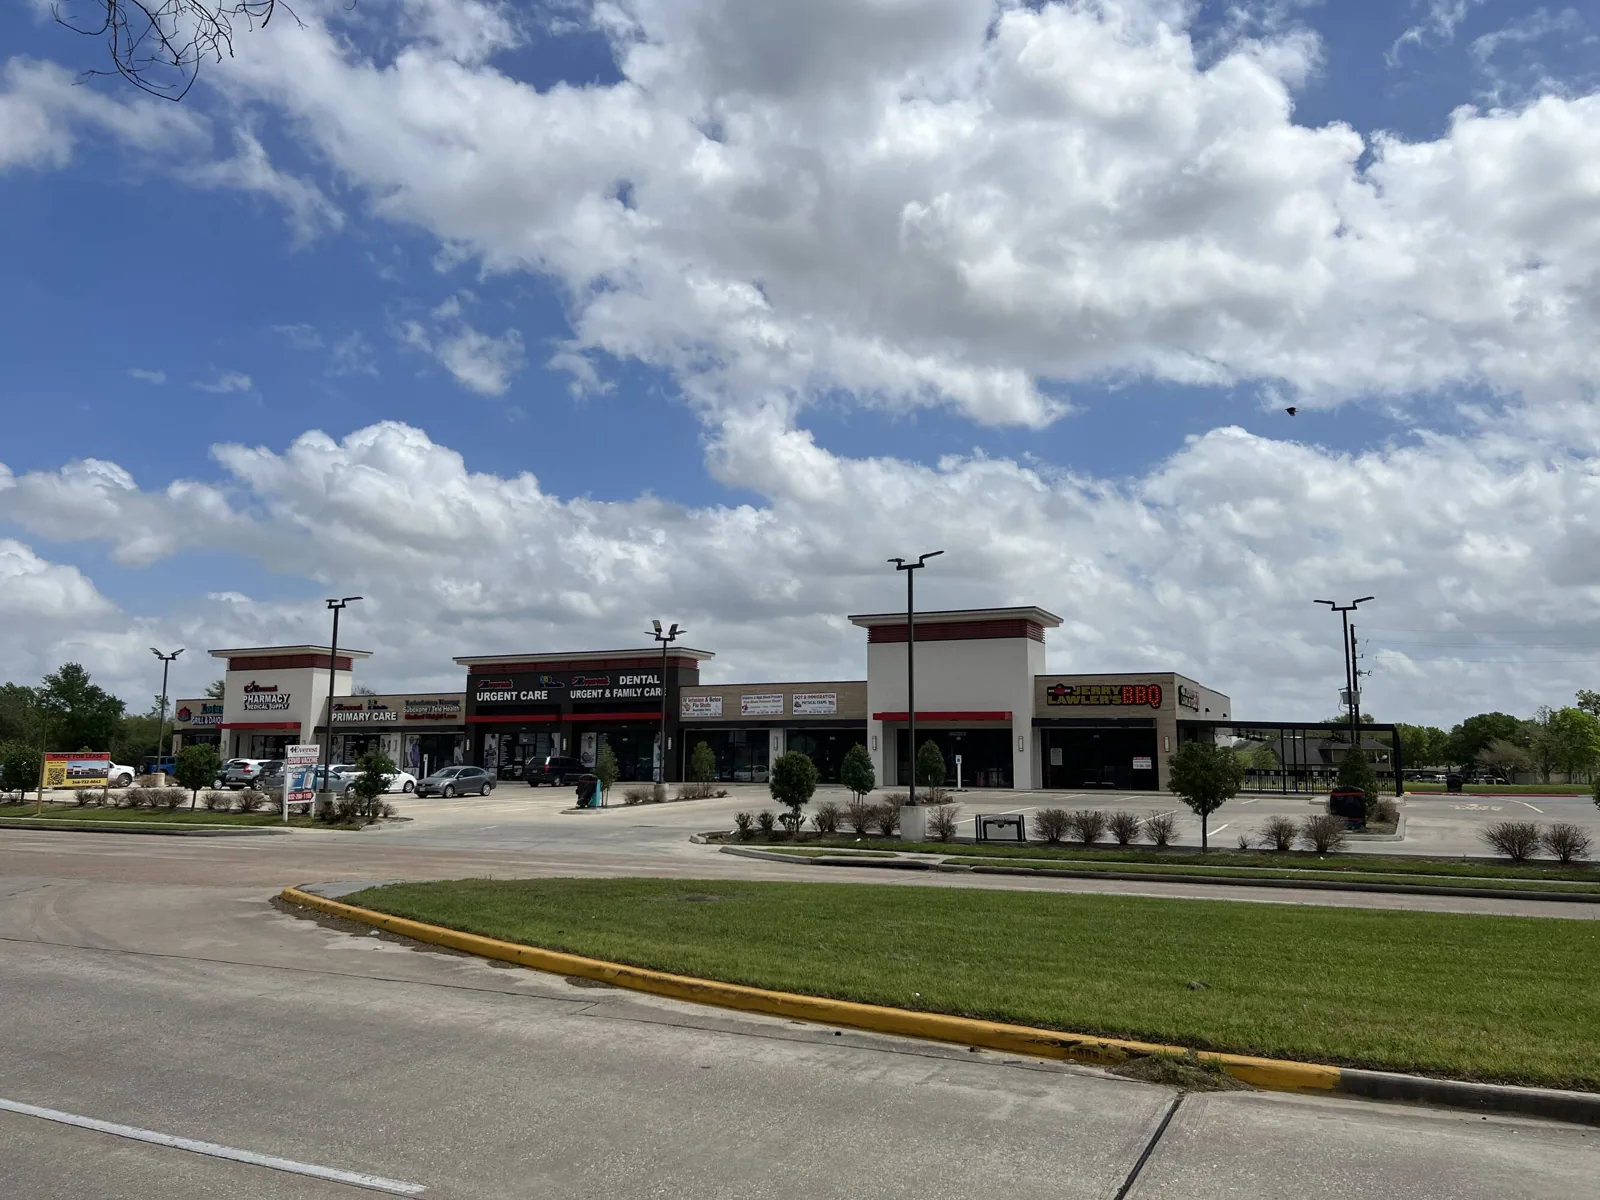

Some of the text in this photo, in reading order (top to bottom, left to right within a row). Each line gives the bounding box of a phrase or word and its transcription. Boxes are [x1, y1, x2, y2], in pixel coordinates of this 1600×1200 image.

[619, 675, 661, 685] DENTAL
[243, 694, 289, 704] PHARMACY
[476, 690, 548, 702] URGENT CARE
[570, 689, 603, 699] URGENT
[604, 689, 611, 698] &
[613, 688, 642, 697] FAMILY
[1072, 686, 1122, 695] JERRY
[1122, 684, 1161, 708] BBQ
[1047, 695, 1122, 704] LAWLER'S
[331, 711, 397, 722] PRIMARY CARE
